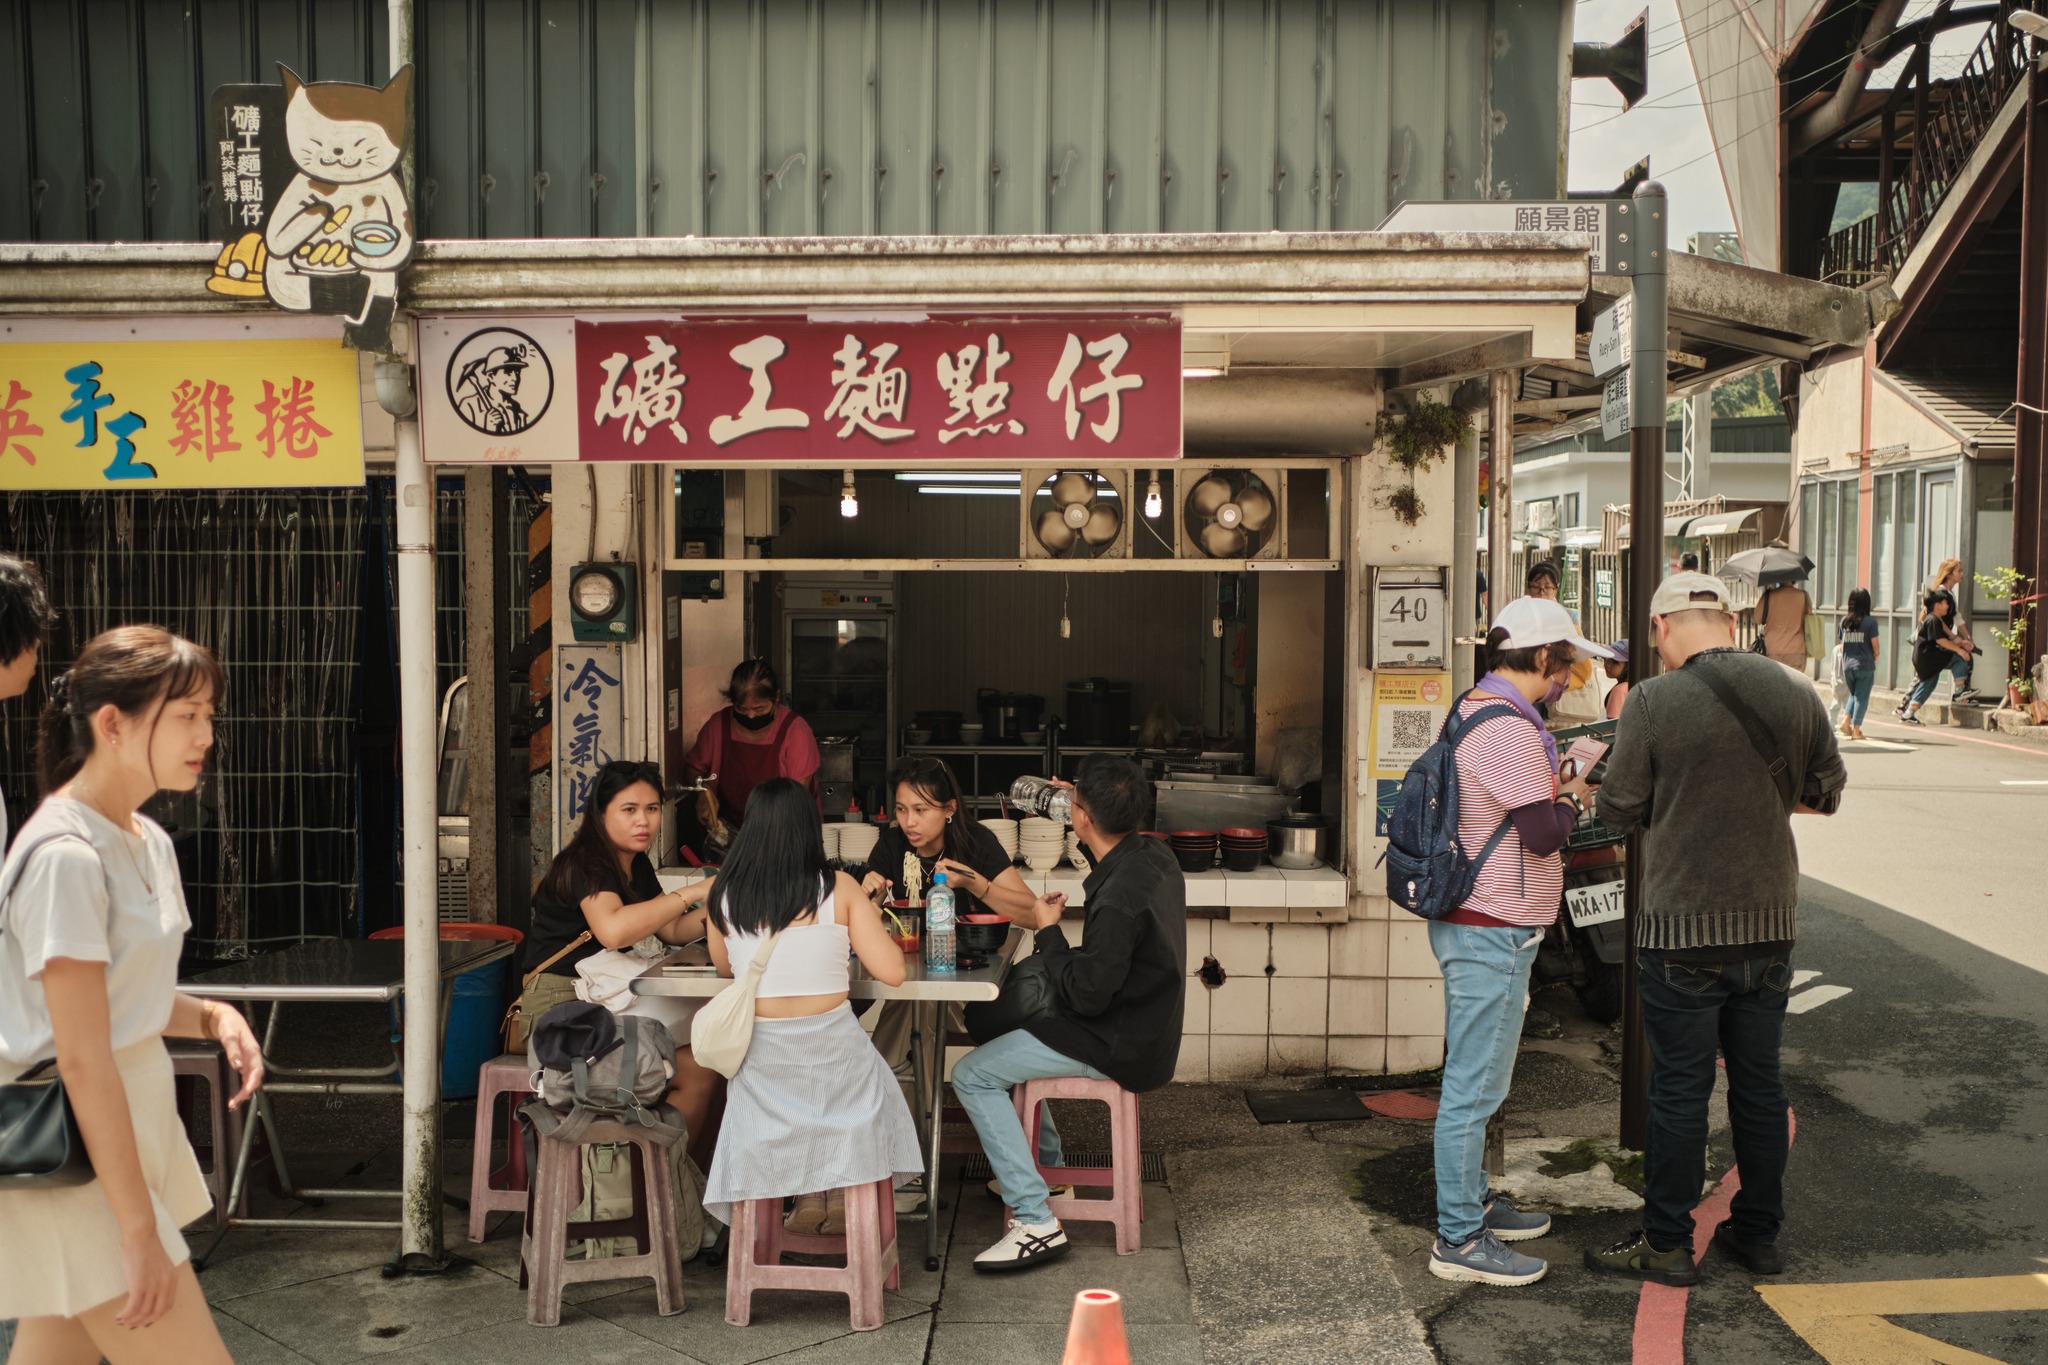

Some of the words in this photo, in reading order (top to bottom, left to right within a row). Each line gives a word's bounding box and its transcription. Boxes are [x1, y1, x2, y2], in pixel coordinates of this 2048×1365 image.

[219, 141, 238, 202] 阿英雞捲
[231, 105, 263, 226] 礦工麵點仔
[1515, 206, 1600, 232] 願景館
[595, 333, 1143, 445] 礦工麵點仔
[1390, 596, 1427, 623] 40
